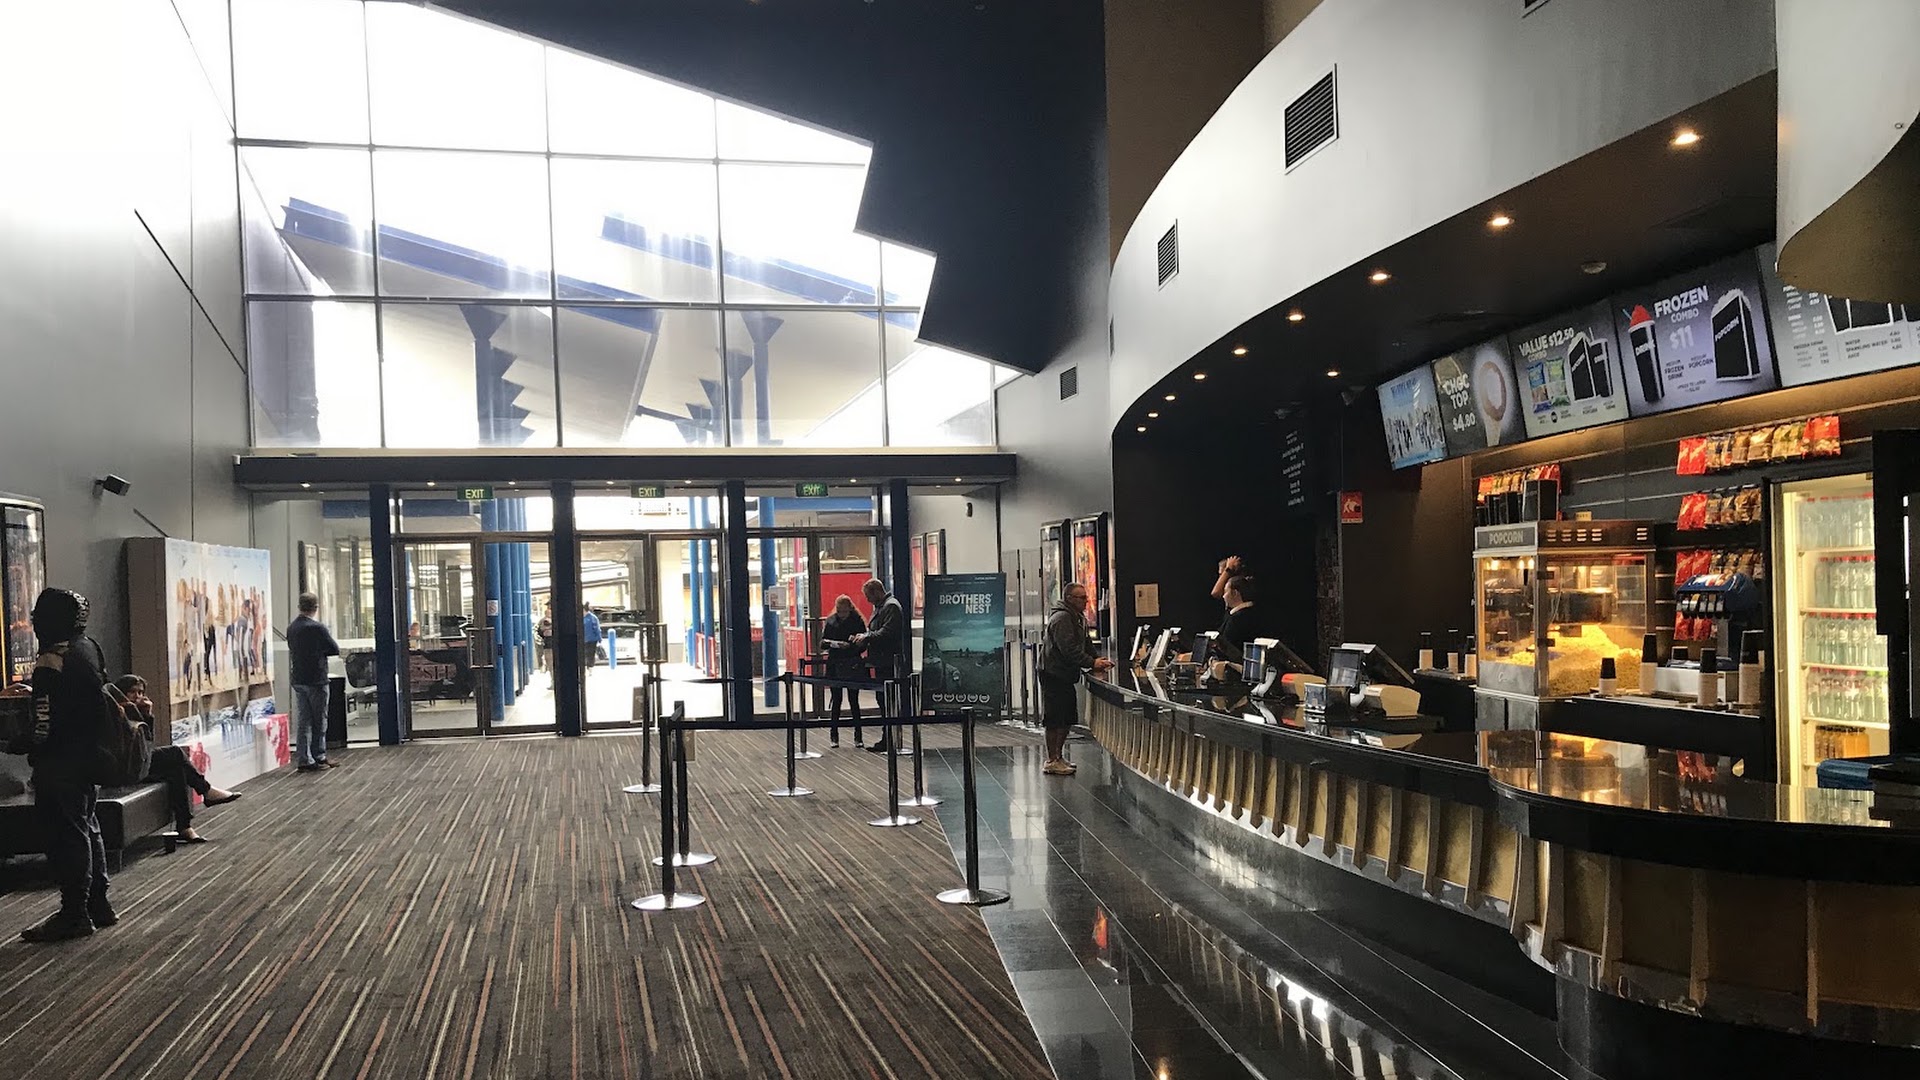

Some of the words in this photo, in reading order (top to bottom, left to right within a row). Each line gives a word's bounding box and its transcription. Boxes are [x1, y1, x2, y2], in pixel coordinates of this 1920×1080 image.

[1654, 285, 1709, 318] FROZEN
[1670, 308, 1699, 323] COMBO
[1715, 316, 1740, 342] POPCORN
[1519, 334, 1549, 357] VALUE
[1548, 327, 1575, 347] $12.50
[1669, 325, 1695, 350] $11
[1635, 339, 1656, 356] DRINK
[1664, 365, 1685, 375] FROZEN
[1688, 358, 1714, 369] POPCORN
[1450, 390, 1469, 409] TOP
[1452, 412, 1476, 432] $4.80
[465, 489, 485, 499] EXIT
[638, 487, 657, 497] EXIT
[1488, 530, 1524, 545] POPCORN
[965, 604, 992, 614] NEST
